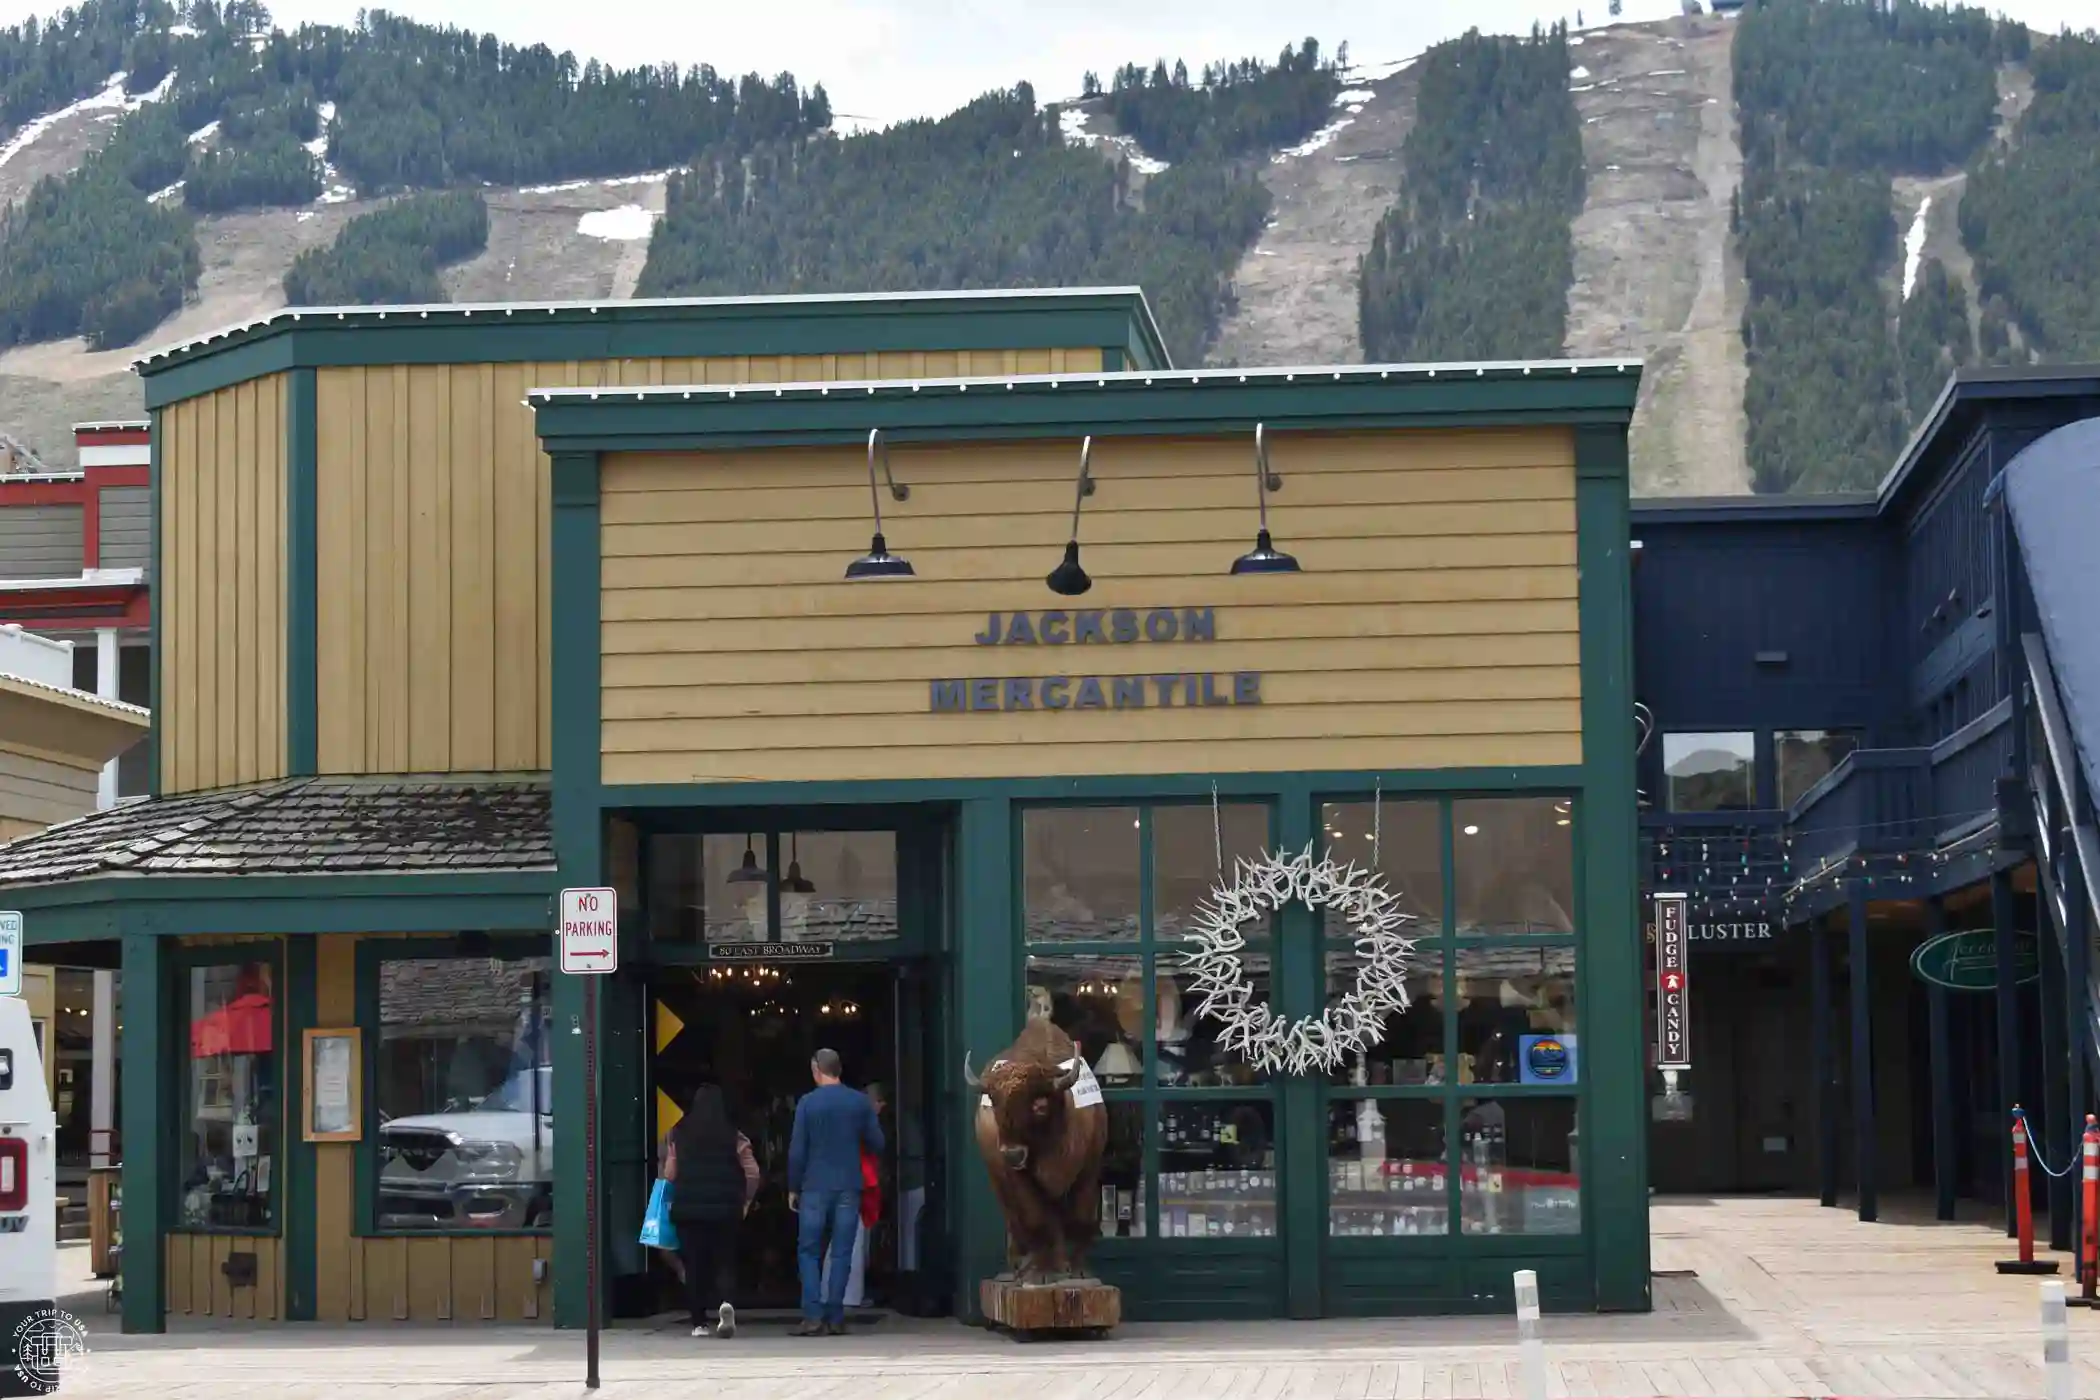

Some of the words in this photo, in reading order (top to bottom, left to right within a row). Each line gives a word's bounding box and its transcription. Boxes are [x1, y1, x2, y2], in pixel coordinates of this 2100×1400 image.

[975, 607, 1216, 645] JACKSON
[929, 671, 1263, 712] MERCANTILE
[578, 896, 598, 912] NO
[565, 921, 612, 937] PARKING
[1665, 907, 1678, 968] FUDGE
[763, 944, 821, 955] BROADWAY
[1667, 993, 1680, 1054] CANDY
